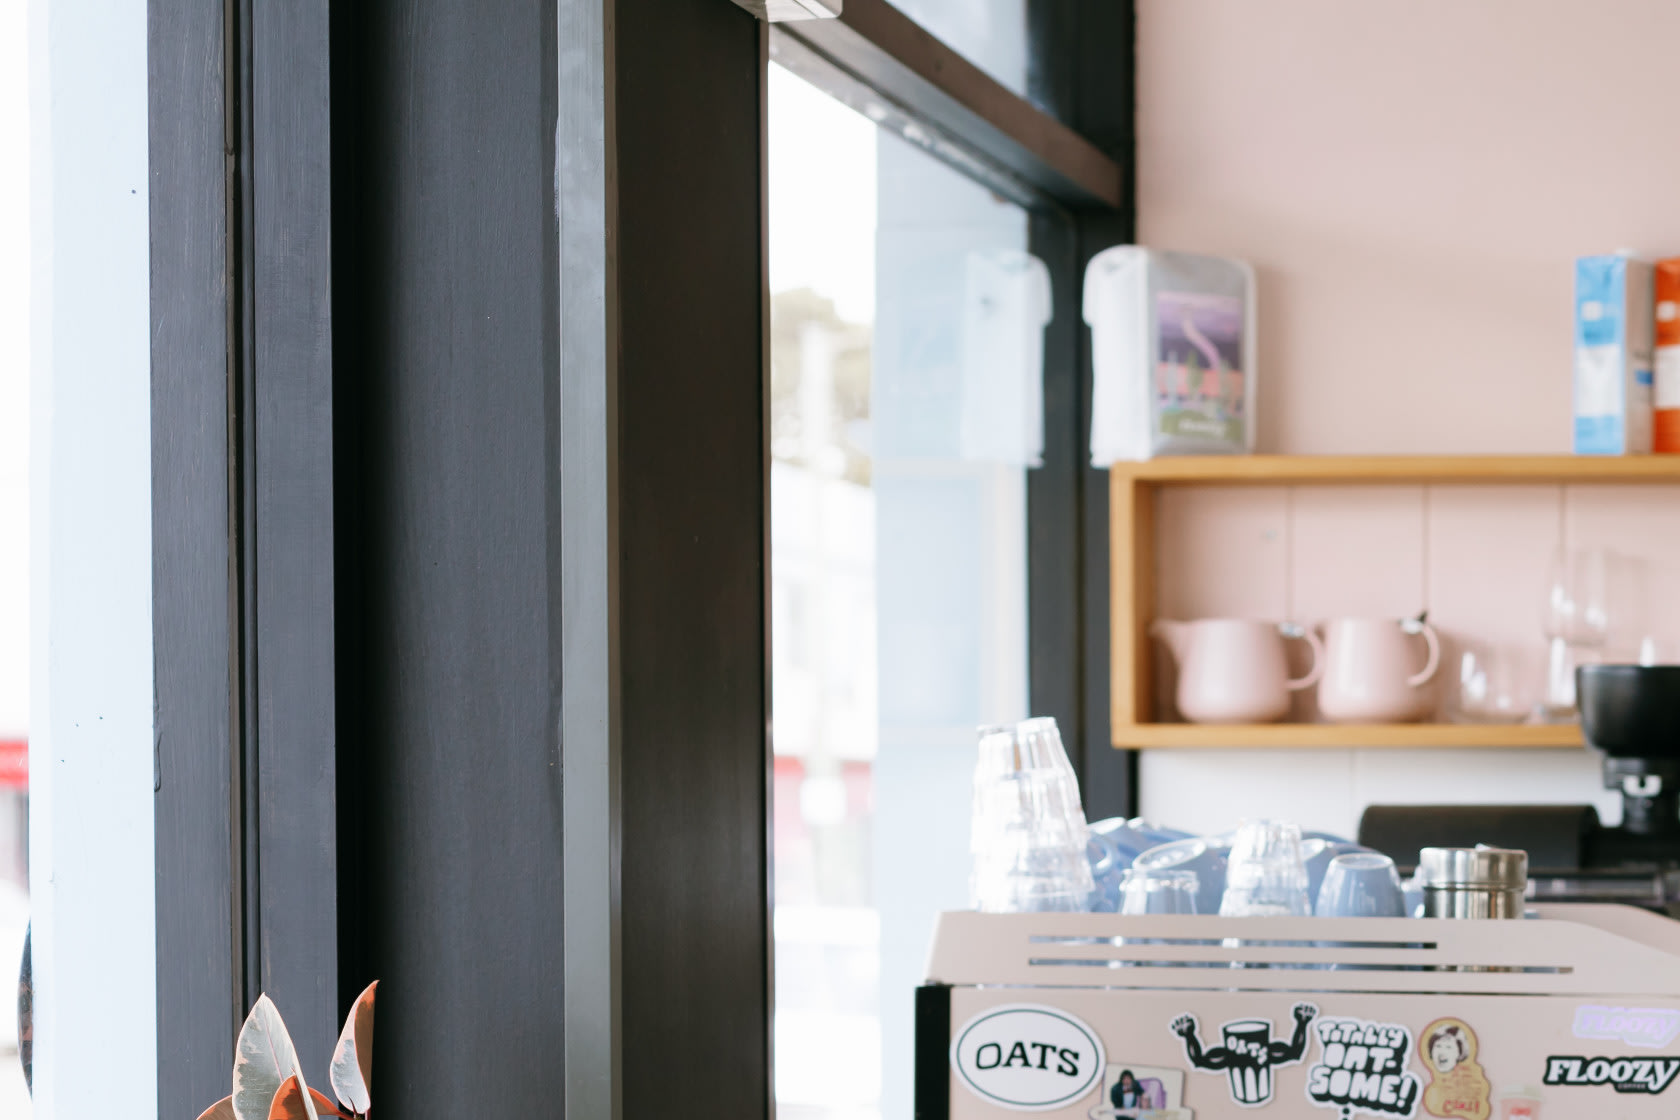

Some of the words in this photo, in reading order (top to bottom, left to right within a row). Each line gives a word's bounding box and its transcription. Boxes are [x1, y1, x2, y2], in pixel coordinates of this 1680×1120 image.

[976, 1041, 1079, 1077] OATS
[1226, 1036, 1268, 1066] OATS
[1325, 1043, 1396, 1074] OAT-
[1310, 1066, 1415, 1108] SOME!
